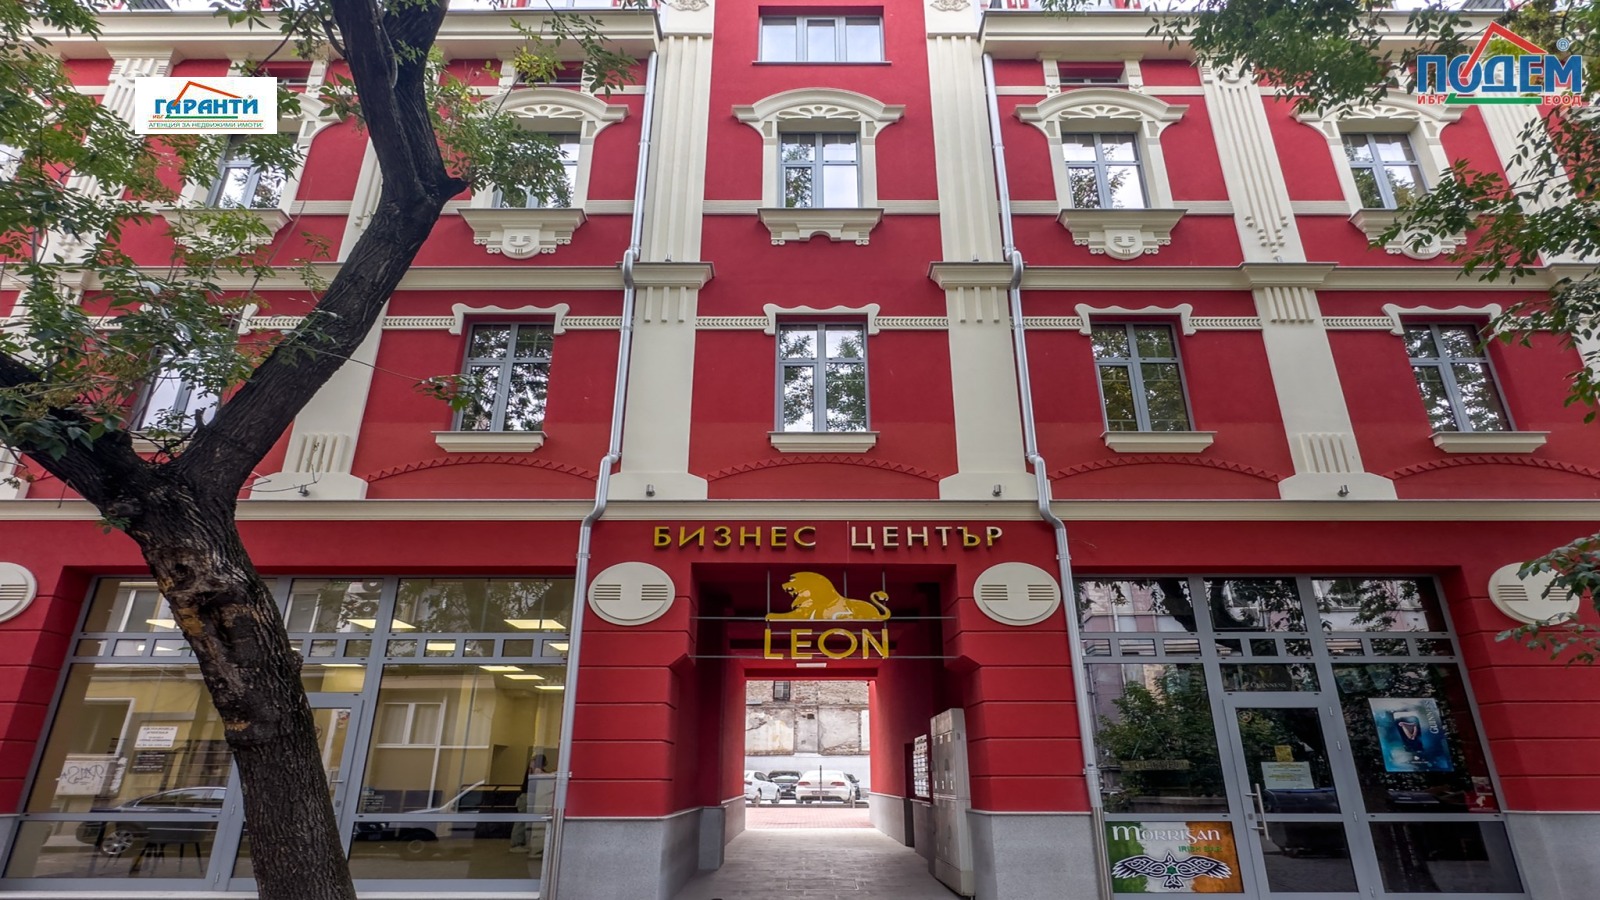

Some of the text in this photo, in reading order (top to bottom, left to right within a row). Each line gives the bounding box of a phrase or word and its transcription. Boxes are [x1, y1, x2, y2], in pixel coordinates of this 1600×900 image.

[653, 526, 1003, 549] БИЗНЕС ЦЕНТЪР
[764, 628, 889, 660] LEON
